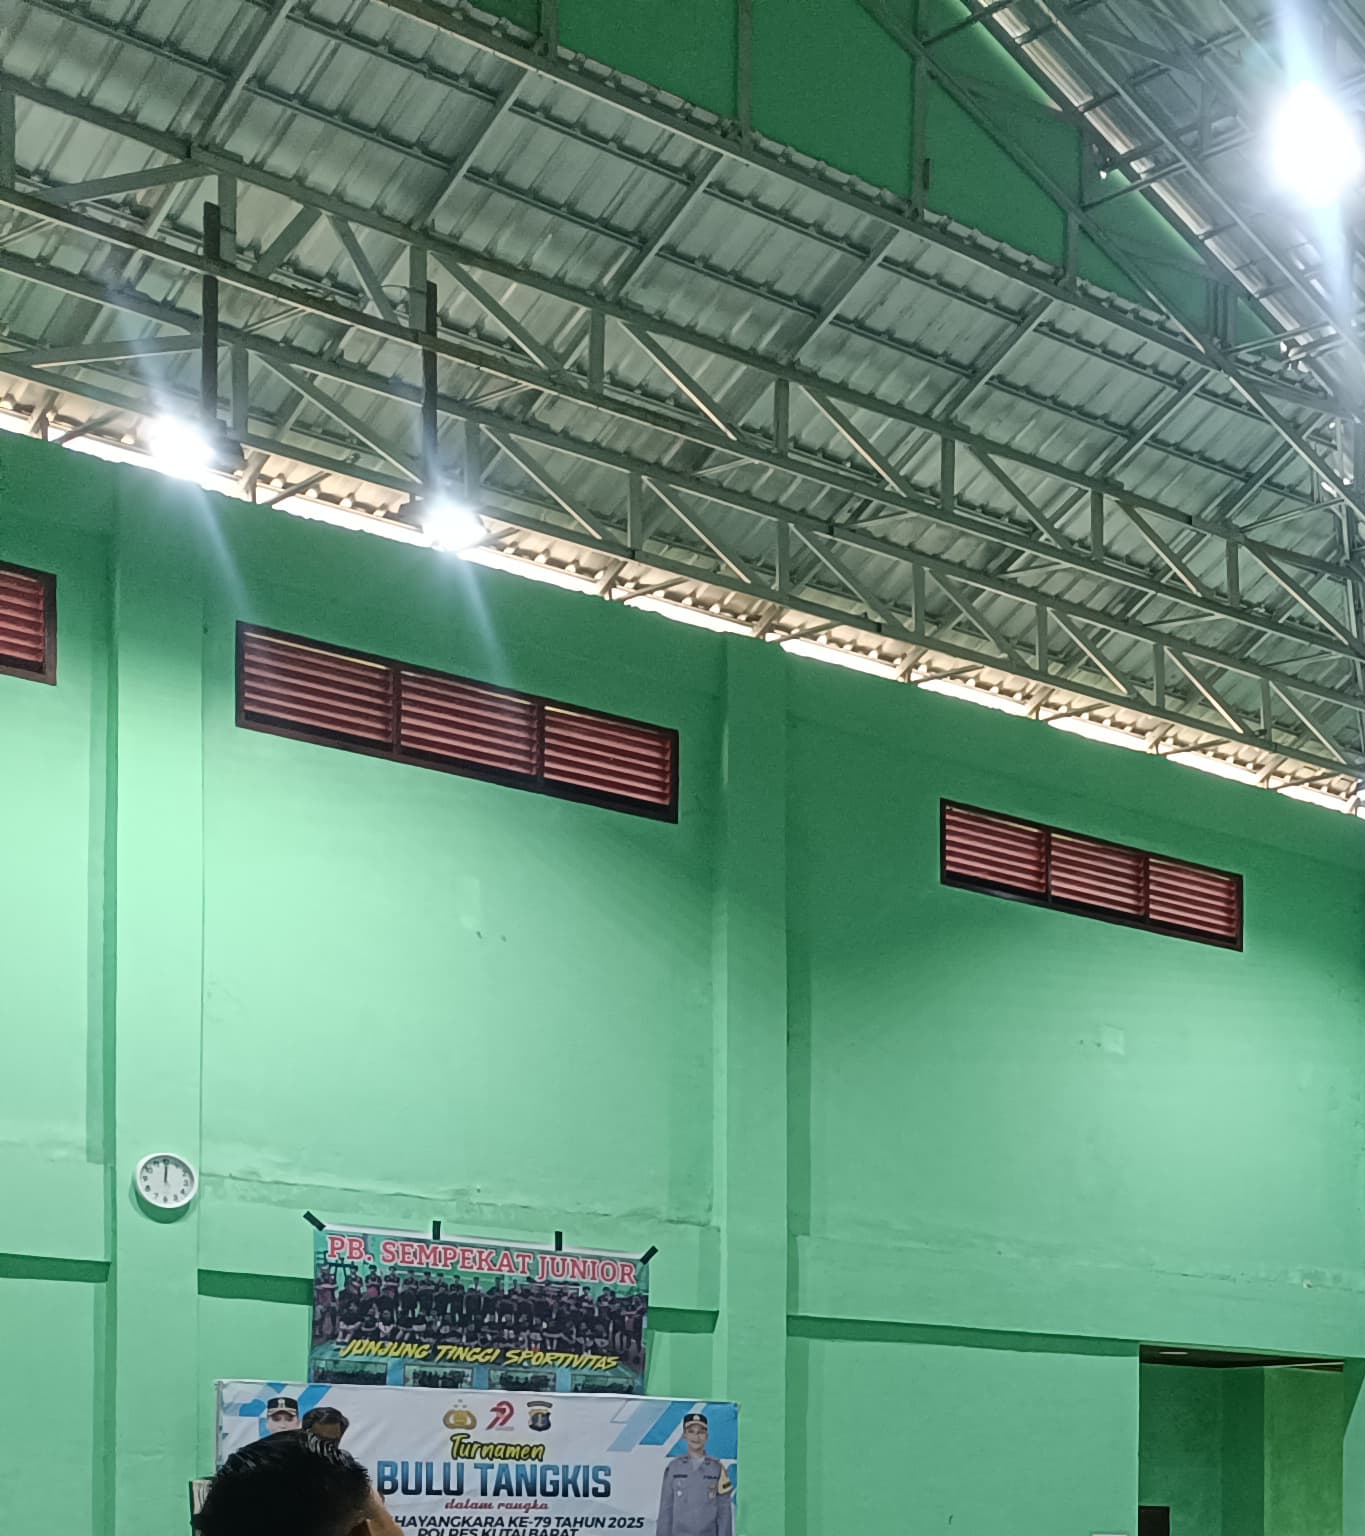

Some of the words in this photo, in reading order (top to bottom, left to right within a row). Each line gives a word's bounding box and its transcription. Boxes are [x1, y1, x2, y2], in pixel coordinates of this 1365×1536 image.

[327, 1235, 373, 1263] PB.
[381, 1239, 534, 1276] SEMPEKAT
[535, 1253, 637, 1286] JUNIOR
[339, 1339, 431, 1359] JUNJUNG
[434, 1344, 501, 1364] TINGGI
[503, 1349, 620, 1371] SPORTIVITAS
[450, 1433, 546, 1461] Turnamen
[376, 1461, 465, 1496] BULU
[474, 1463, 611, 1498] TANGKIS
[444, 1498, 494, 1510] dalam
[497, 1499, 549, 1514] rangka
[395, 1515, 505, 1528] HAYANGKARA
[508, 1516, 552, 1528] KE-79
[554, 1516, 606, 1529] TAHUN
[607, 1516, 645, 1529] 2025
